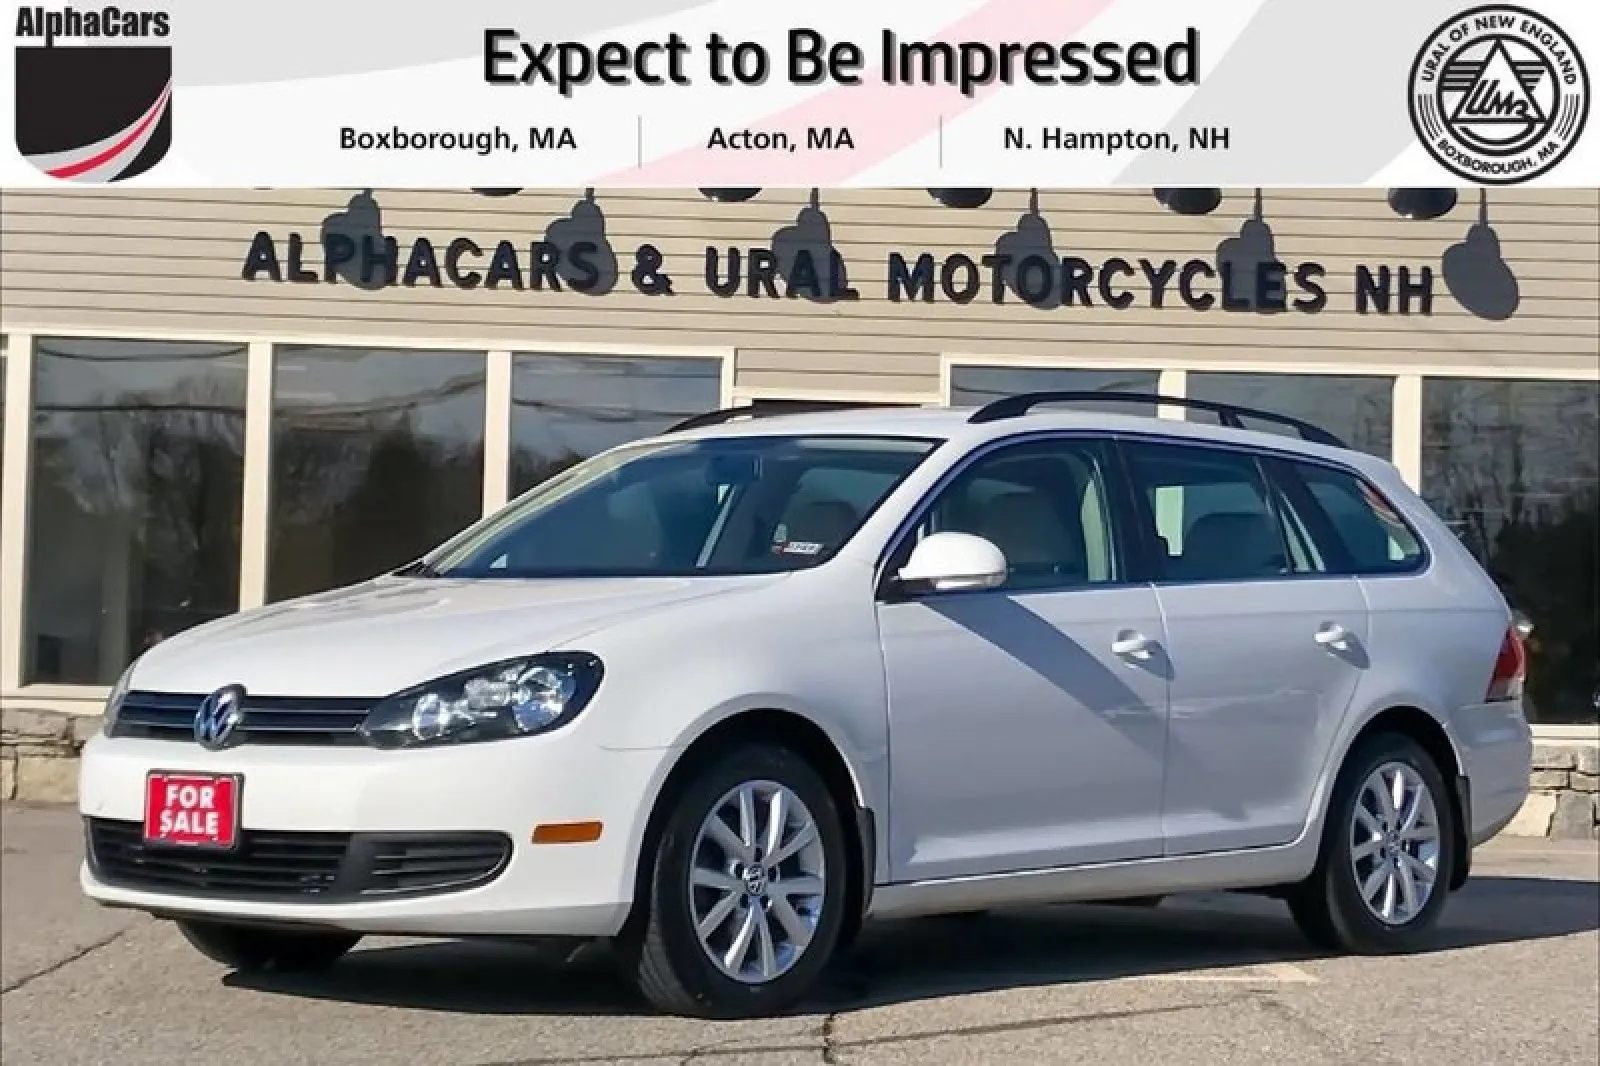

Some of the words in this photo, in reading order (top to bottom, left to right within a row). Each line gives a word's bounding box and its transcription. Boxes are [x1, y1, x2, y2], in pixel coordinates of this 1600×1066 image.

[242, 231, 599, 292] ALPHACARS
[631, 244, 674, 296] &
[706, 246, 860, 299] URAL
[888, 252, 1326, 313] MOTORCYCLES
[1355, 264, 1432, 315] NH
[166, 784, 215, 809] FOR
[160, 810, 219, 836] SALE
